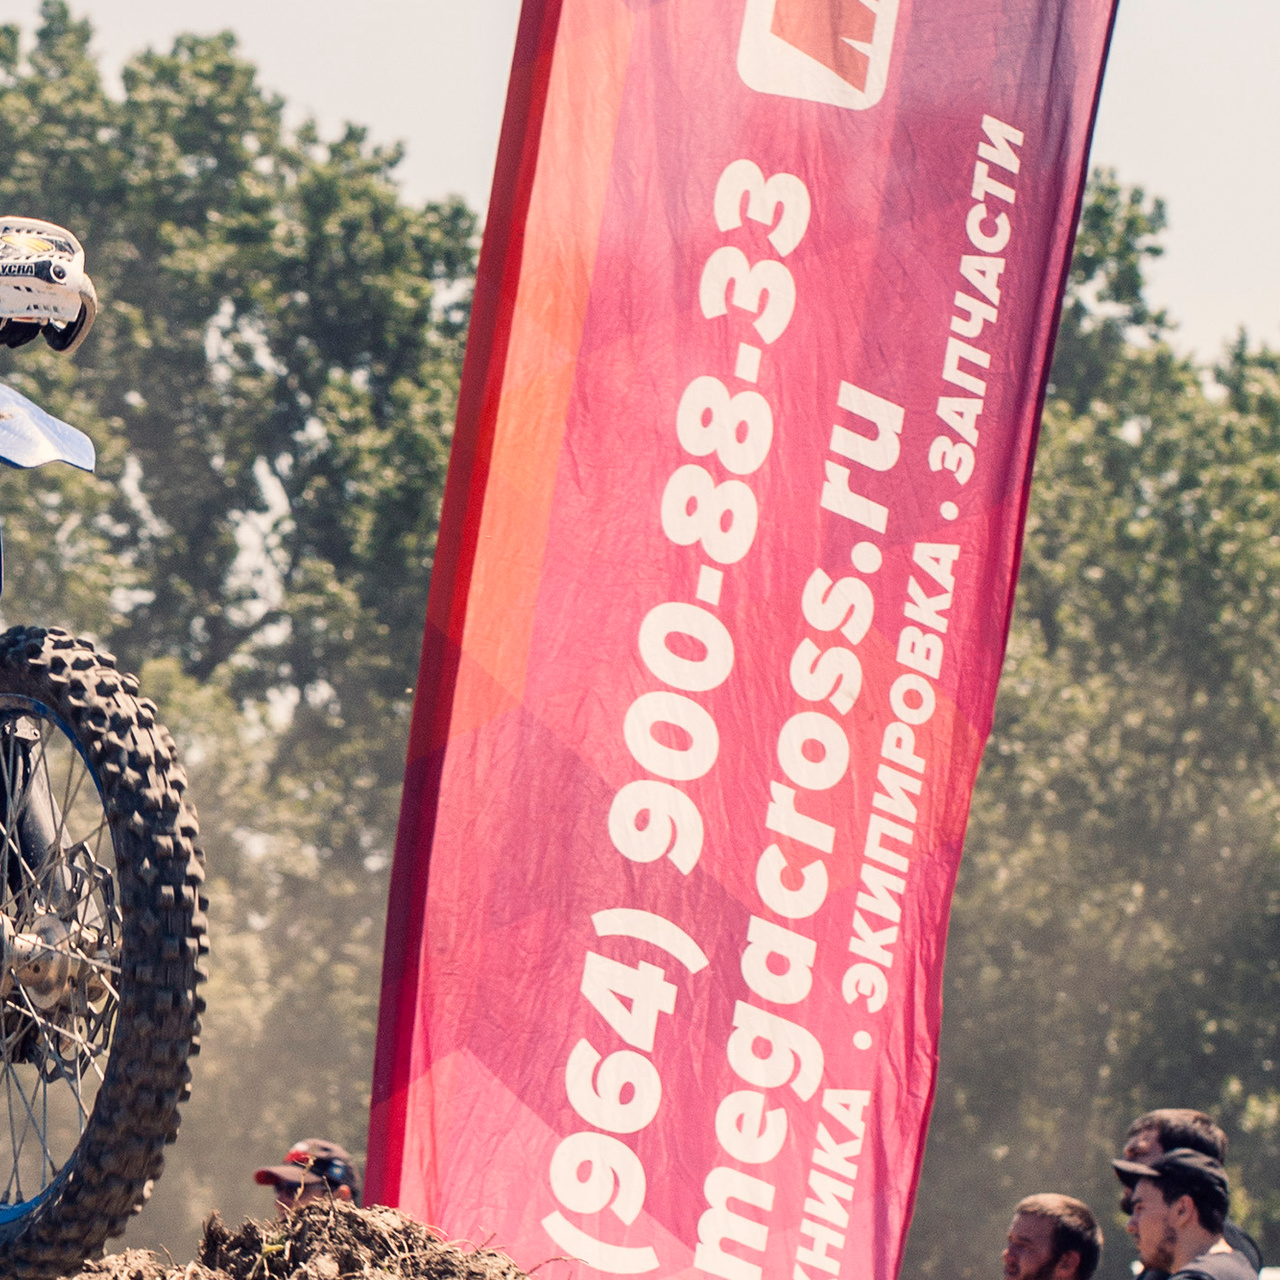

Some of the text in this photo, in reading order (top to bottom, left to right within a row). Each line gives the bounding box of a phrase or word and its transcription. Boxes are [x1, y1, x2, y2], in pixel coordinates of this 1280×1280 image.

[541, 160, 810, 1274] (964) 900-88-33
[842, 543, 959, 1012] ЭКИПИРОВКА
[929, 114, 1024, 485] ЗАПЧАСТИ
